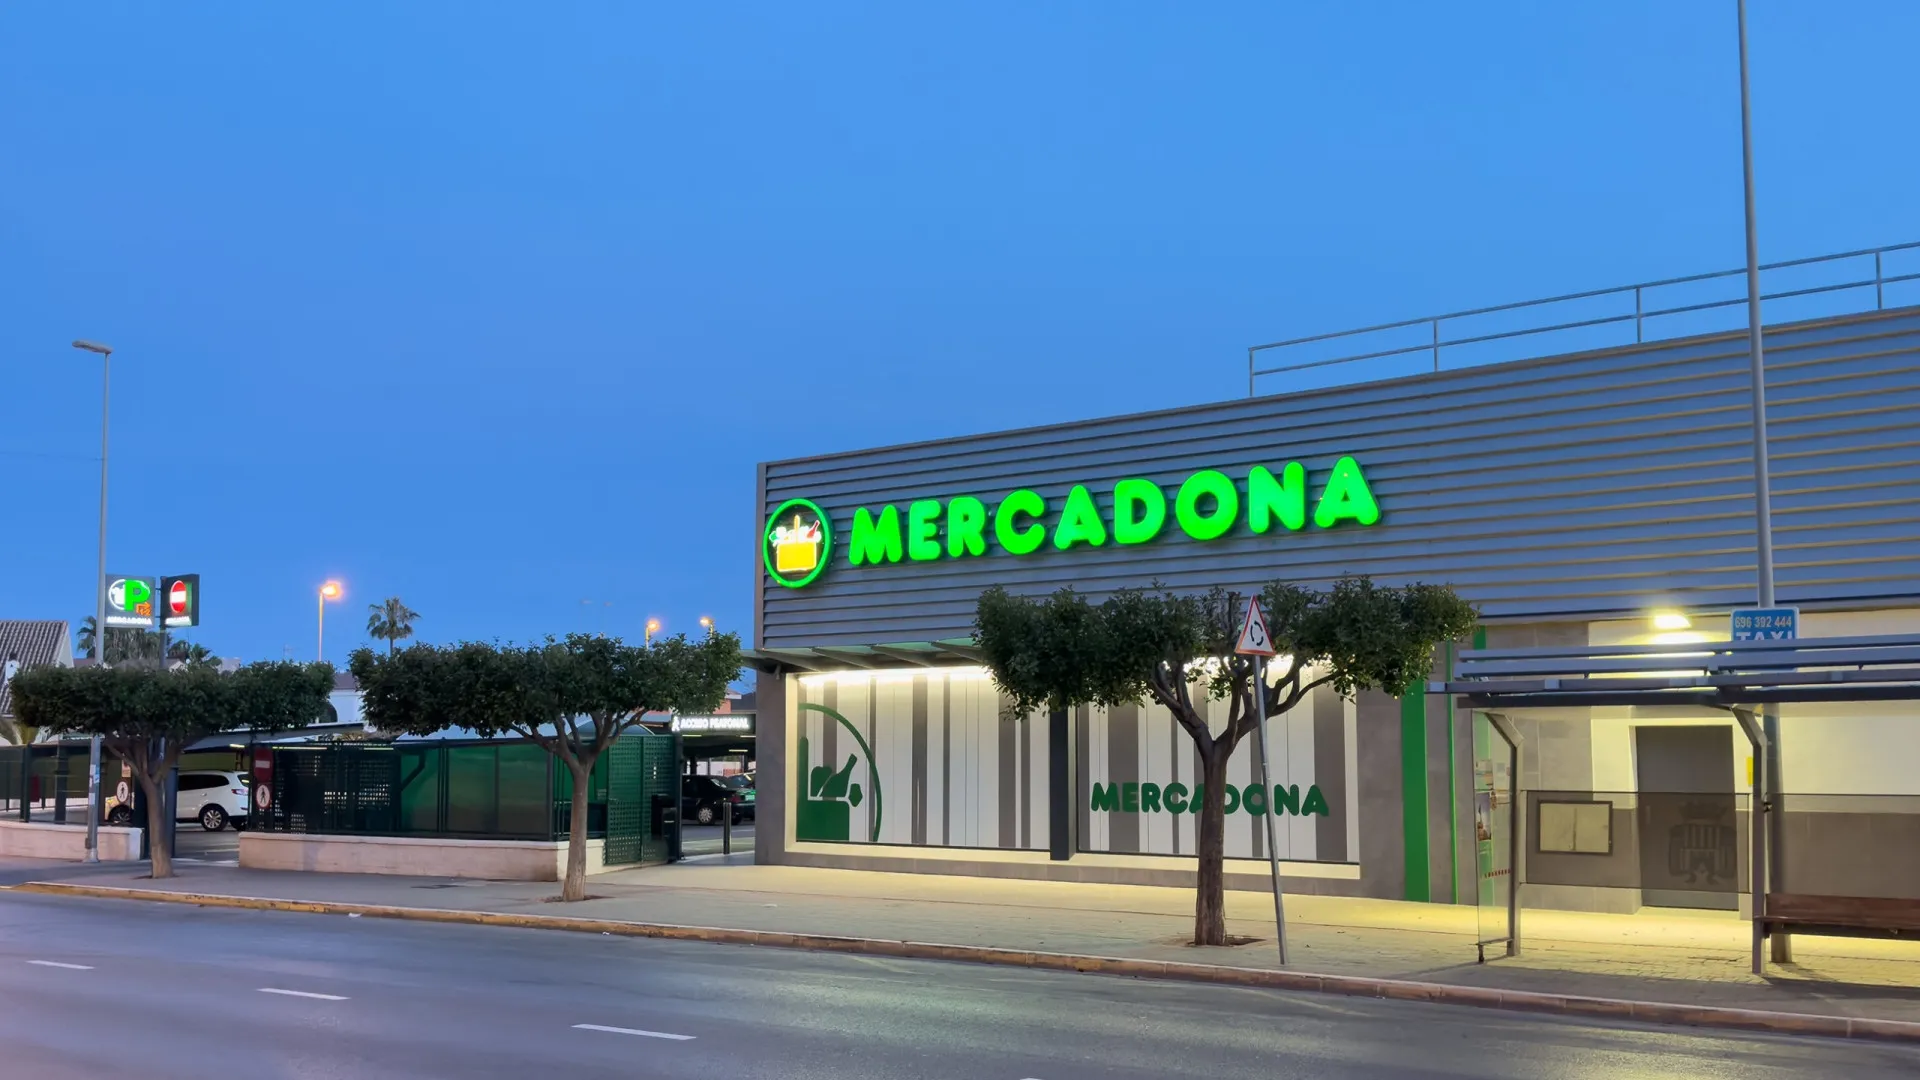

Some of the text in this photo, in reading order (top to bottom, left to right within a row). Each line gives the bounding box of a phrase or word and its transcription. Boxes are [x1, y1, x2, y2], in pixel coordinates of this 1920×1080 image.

[848, 456, 1380, 566] MERCADONA
[124, 579, 150, 611] P
[1774, 616, 1792, 628] 444
